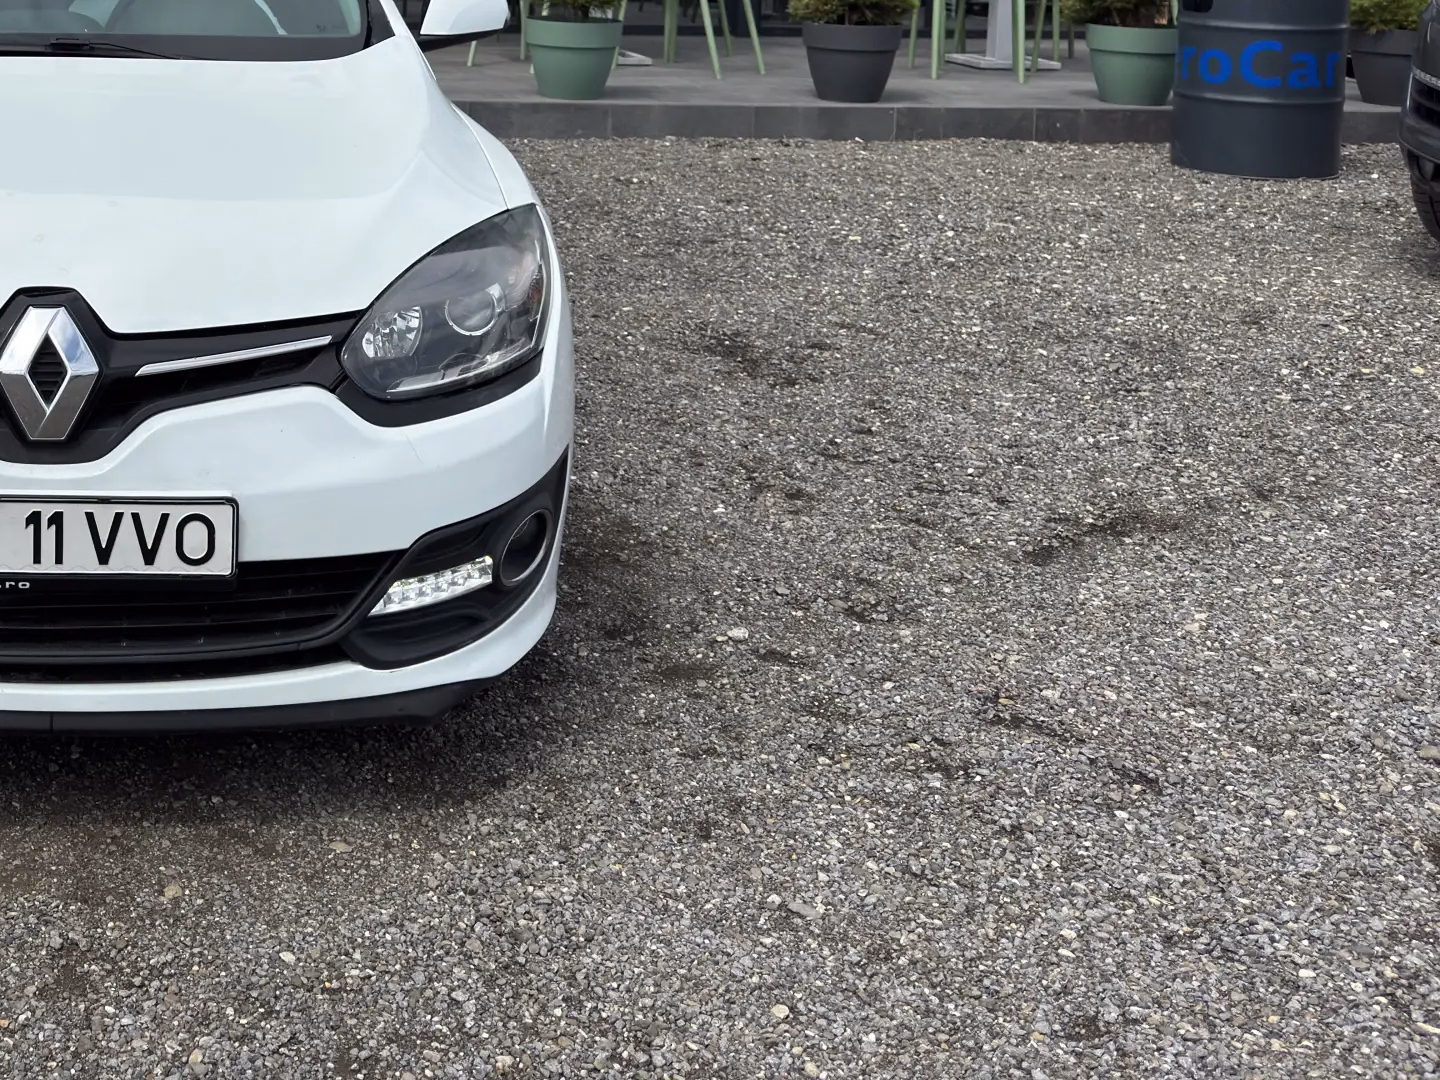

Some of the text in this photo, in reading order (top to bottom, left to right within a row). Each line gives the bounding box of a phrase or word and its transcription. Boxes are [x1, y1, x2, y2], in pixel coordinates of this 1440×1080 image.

[1177, 40, 1342, 89] roCar
[24, 510, 64, 565] 11
[84, 512, 216, 567] VVO
